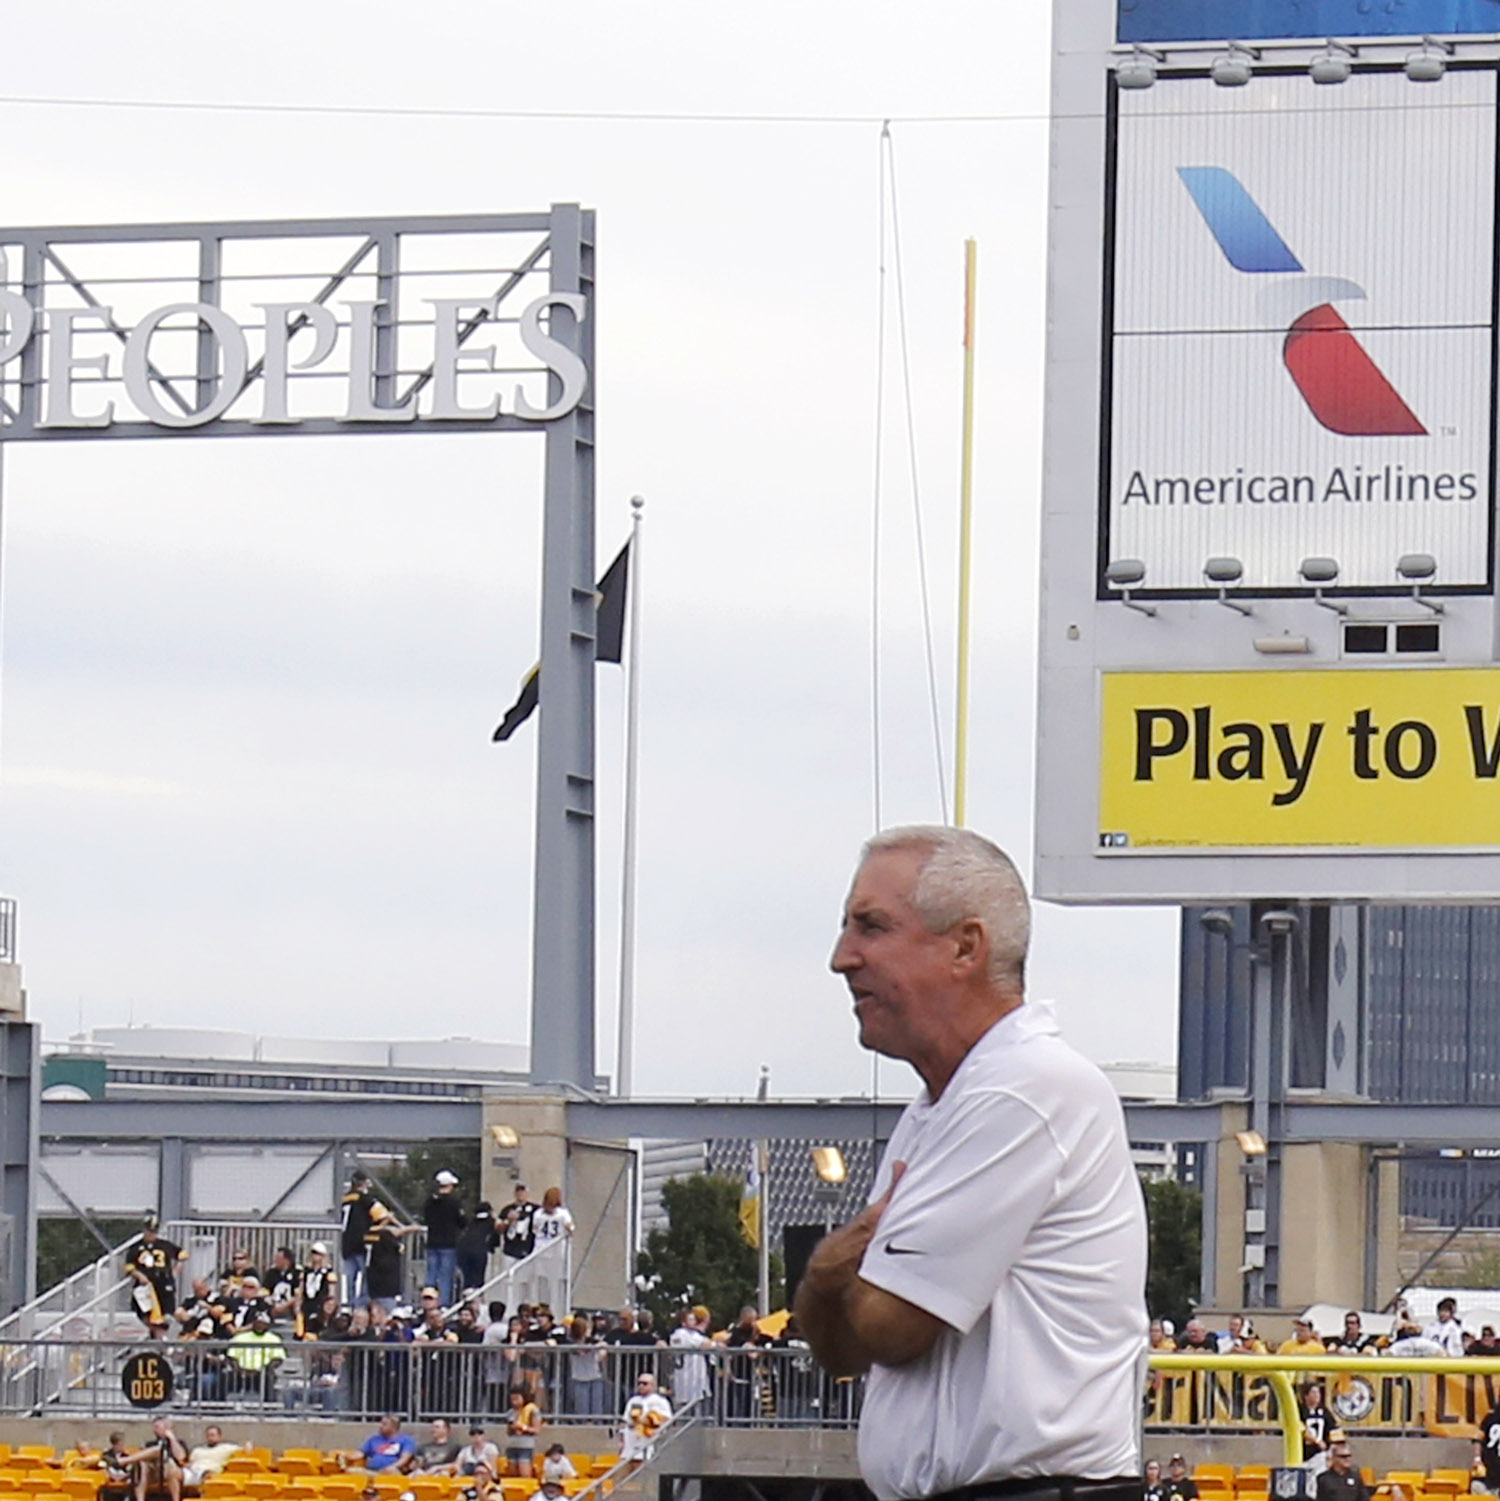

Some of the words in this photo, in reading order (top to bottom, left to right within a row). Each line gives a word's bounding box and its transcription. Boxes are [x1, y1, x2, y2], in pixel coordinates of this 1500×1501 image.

[1122, 469, 1314, 505] American
[1323, 465, 1477, 502] Airlines
[1133, 705, 1326, 807] Play
[1347, 709, 1437, 780] to
[137, 1359, 159, 1379] LC
[131, 1381, 164, 1400] 003
